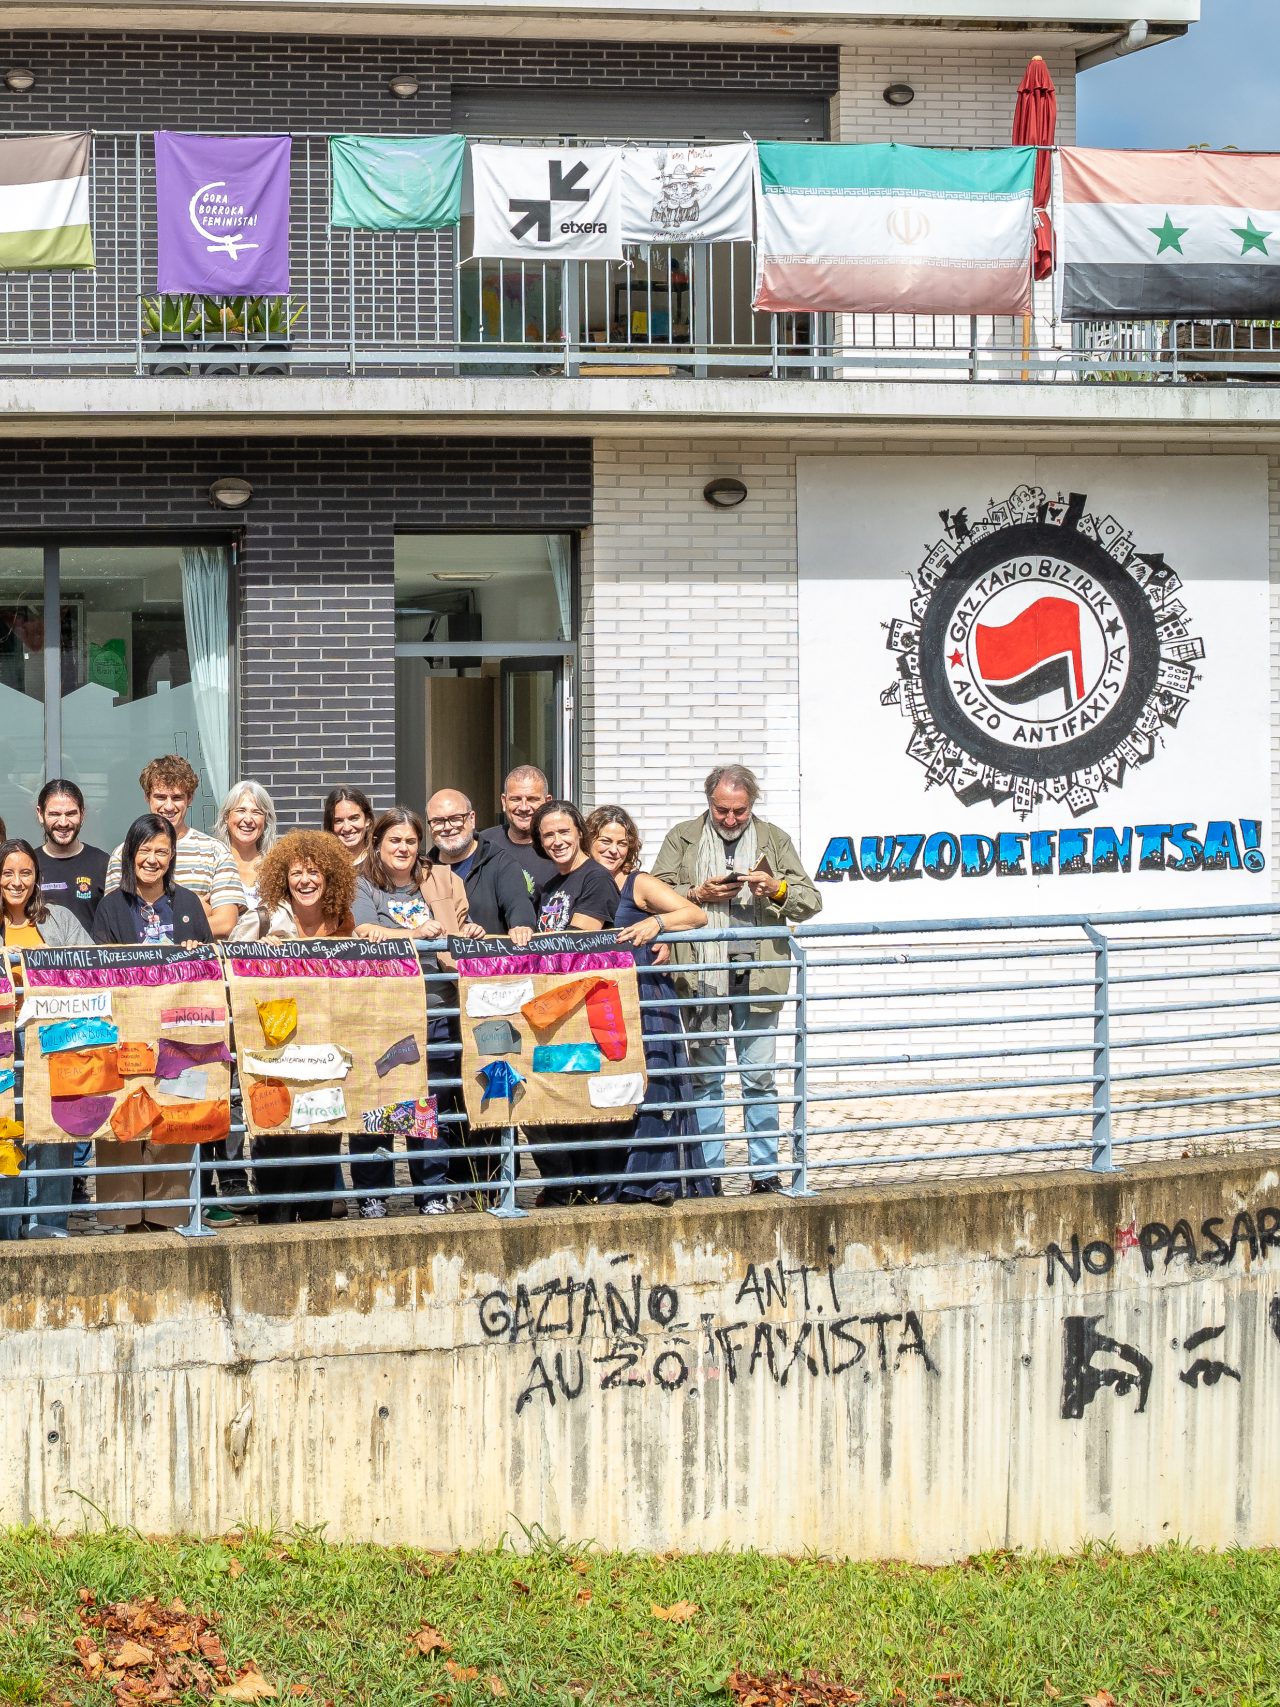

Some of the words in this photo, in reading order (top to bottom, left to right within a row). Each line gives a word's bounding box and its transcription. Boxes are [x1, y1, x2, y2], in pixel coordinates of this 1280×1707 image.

[198, 204, 245, 215] BORROKA
[202, 192, 228, 204] GORA
[202, 214, 258, 227] FEMINISTA!
[560, 220, 608, 234] etxera
[1038, 559, 1112, 615] BIZIRIK
[953, 679, 1001, 730] AUZO
[1013, 645, 1126, 742] ANTIFAXISTA
[814, 818, 1266, 883] AUZODEFENTSA!
[1045, 1233, 1114, 1287] NO
